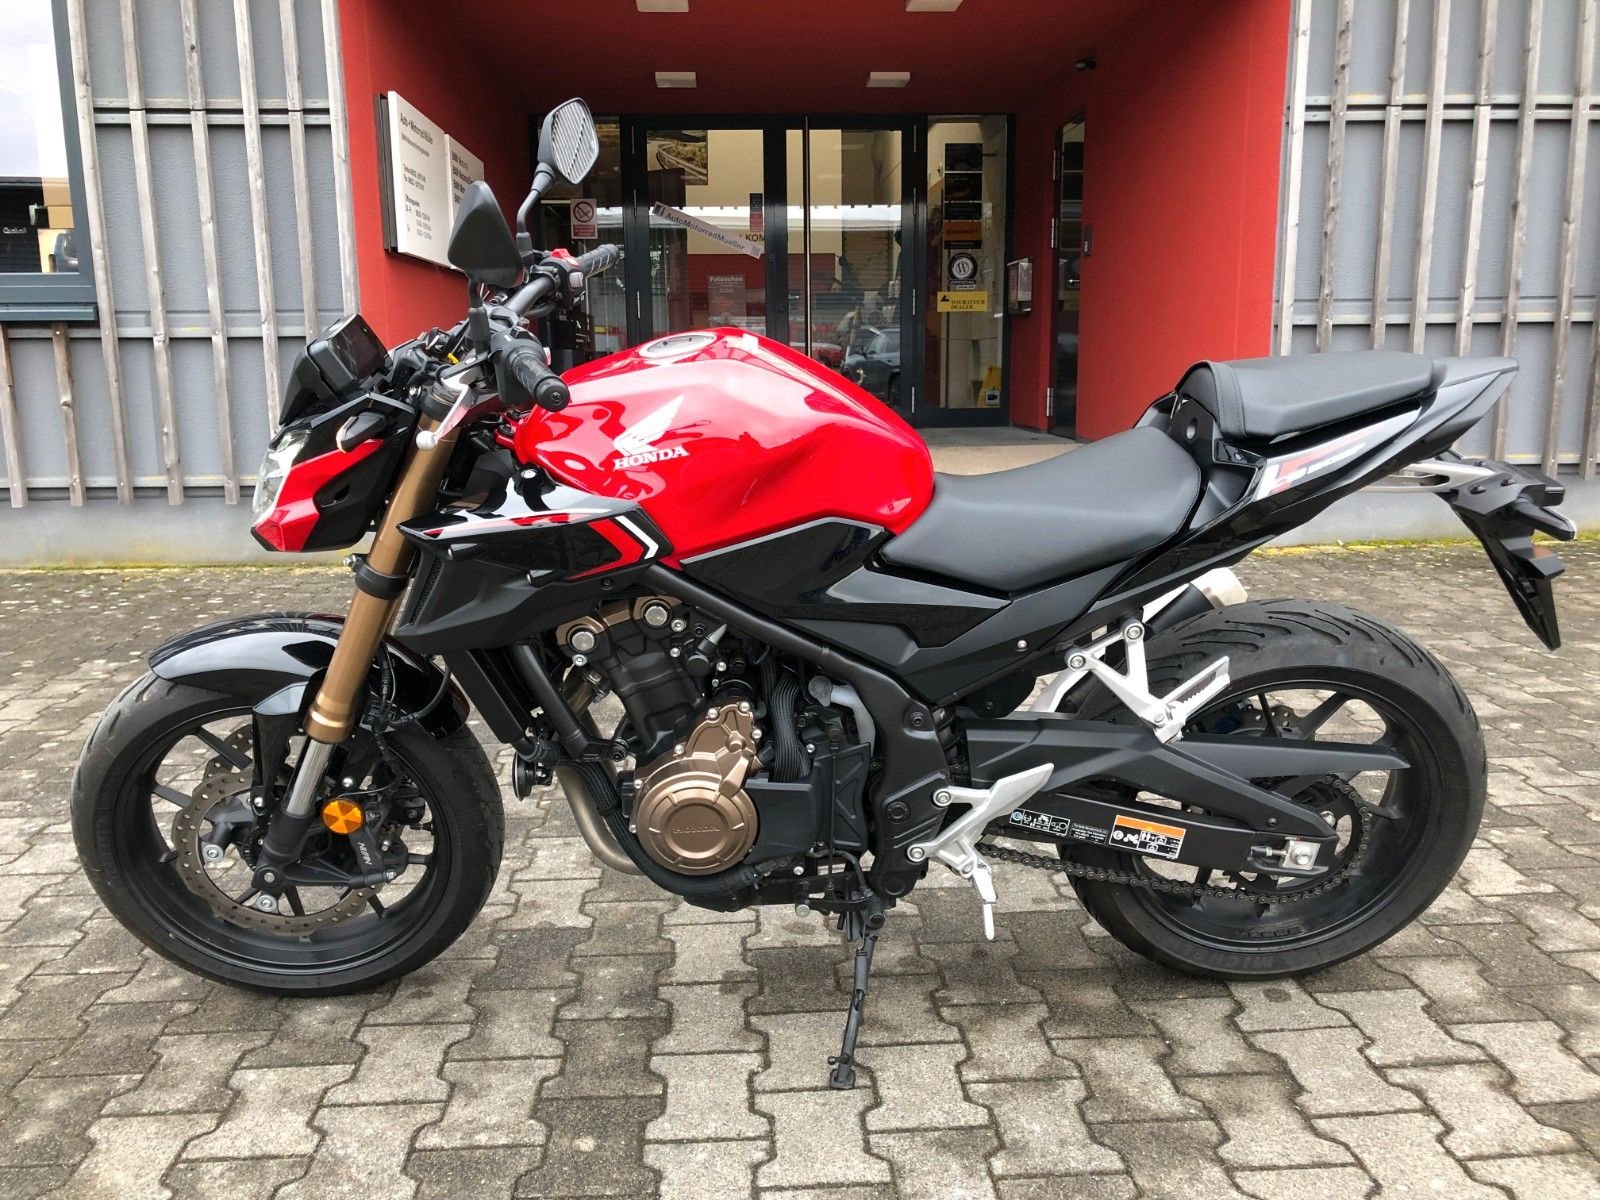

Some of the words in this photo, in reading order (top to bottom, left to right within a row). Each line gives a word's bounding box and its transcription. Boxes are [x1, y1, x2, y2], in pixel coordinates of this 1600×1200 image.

[666, 211, 746, 250] AutoMotorradMueller
[613, 447, 689, 469] HONDA
[673, 824, 721, 834] HONDA
